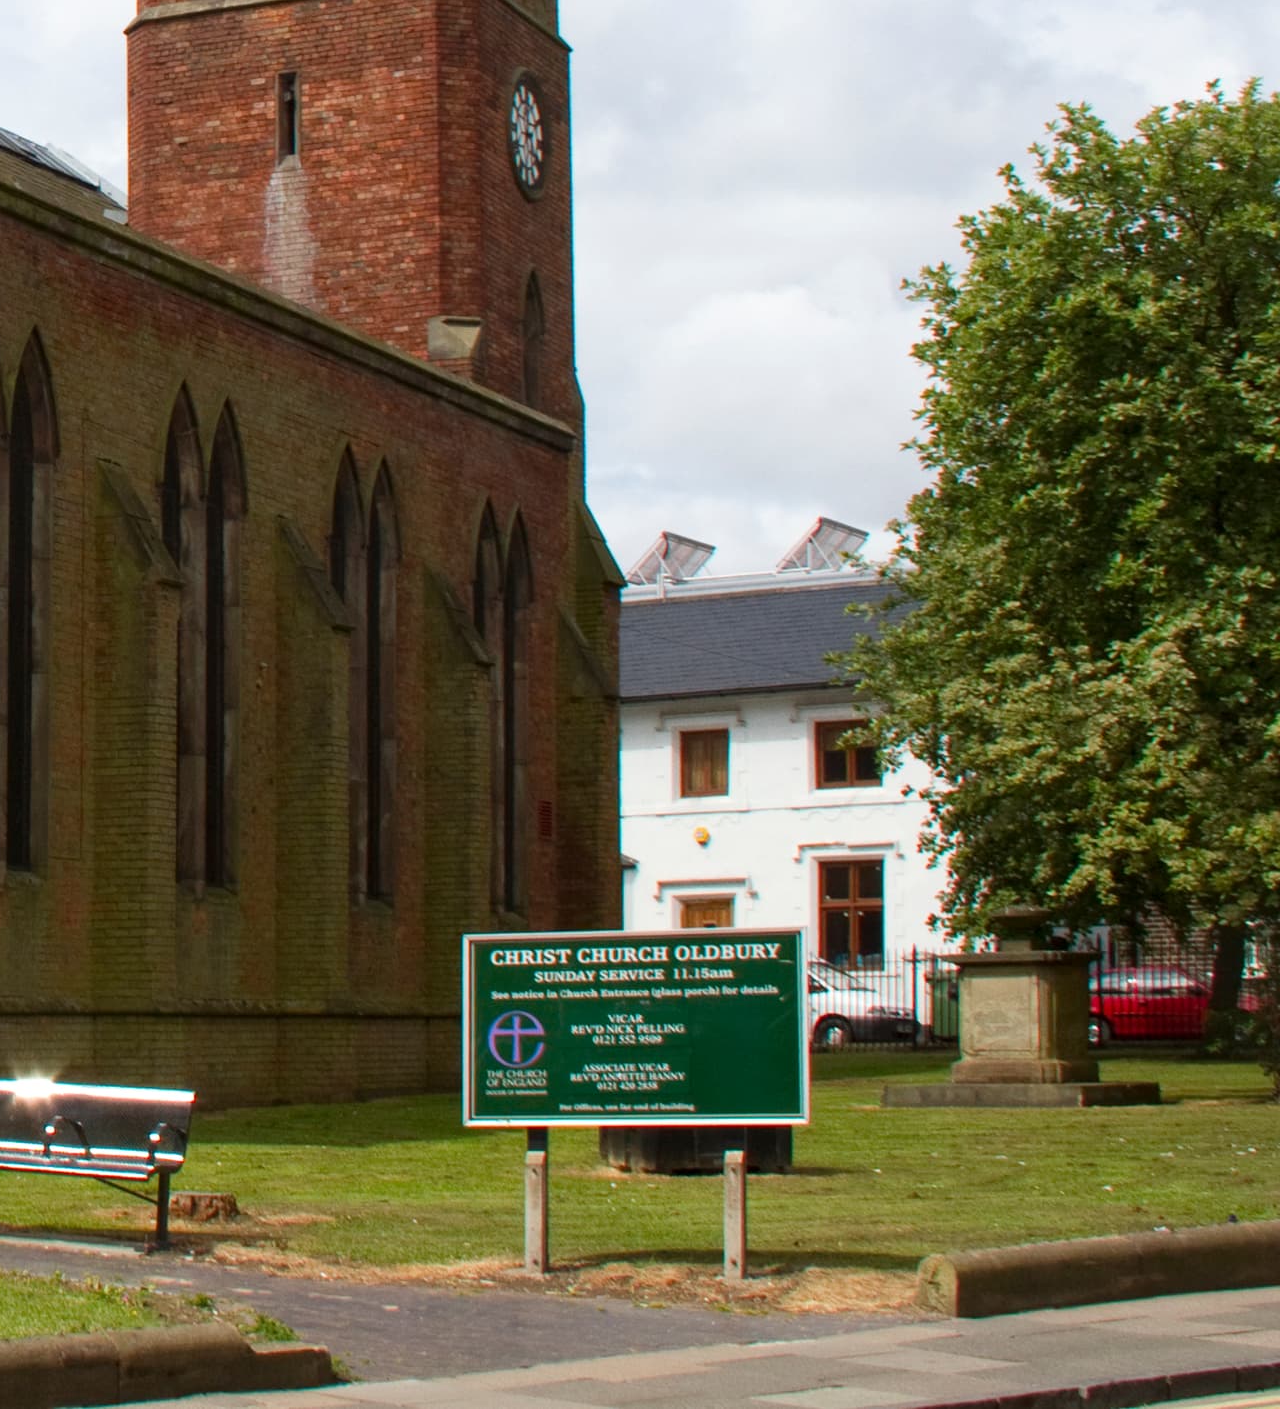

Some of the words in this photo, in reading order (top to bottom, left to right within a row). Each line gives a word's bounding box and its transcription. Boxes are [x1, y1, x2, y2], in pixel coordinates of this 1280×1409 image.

[490, 948, 572, 966] CHRIST
[576, 945, 669, 964] CHURCH
[674, 943, 780, 962] OLDBURY
[534, 970, 597, 983] SUNDAY
[599, 968, 665, 982] SERVICE
[673, 967, 734, 980] 11.15am
[491, 991, 510, 1000] See
[511, 989, 545, 999] notice
[547, 989, 558, 999] in
[560, 988, 598, 999] Church
[600, 988, 650, 998] Entrance
[651, 986, 683, 999] (glass
[684, 985, 720, 998] porch)
[722, 985, 738, 995] for
[740, 984, 779, 996] details
[607, 1013, 644, 1024] VICAR
[571, 1024, 605, 1035] REV'D
[606, 1024, 635, 1034] NICK
[637, 1023, 686, 1034] PELLING
[592, 1034, 616, 1045] 0121
[583, 1062, 637, 1072] ASSOCIATE
[638, 1062, 670, 1072] VICAR
[487, 1069, 504, 1078] THE
[506, 1069, 548, 1078] CHURCH
[601, 1072, 647, 1082] ANNETTE
[486, 1078, 500, 1087] OF
[502, 1078, 548, 1087] ENGLAND
